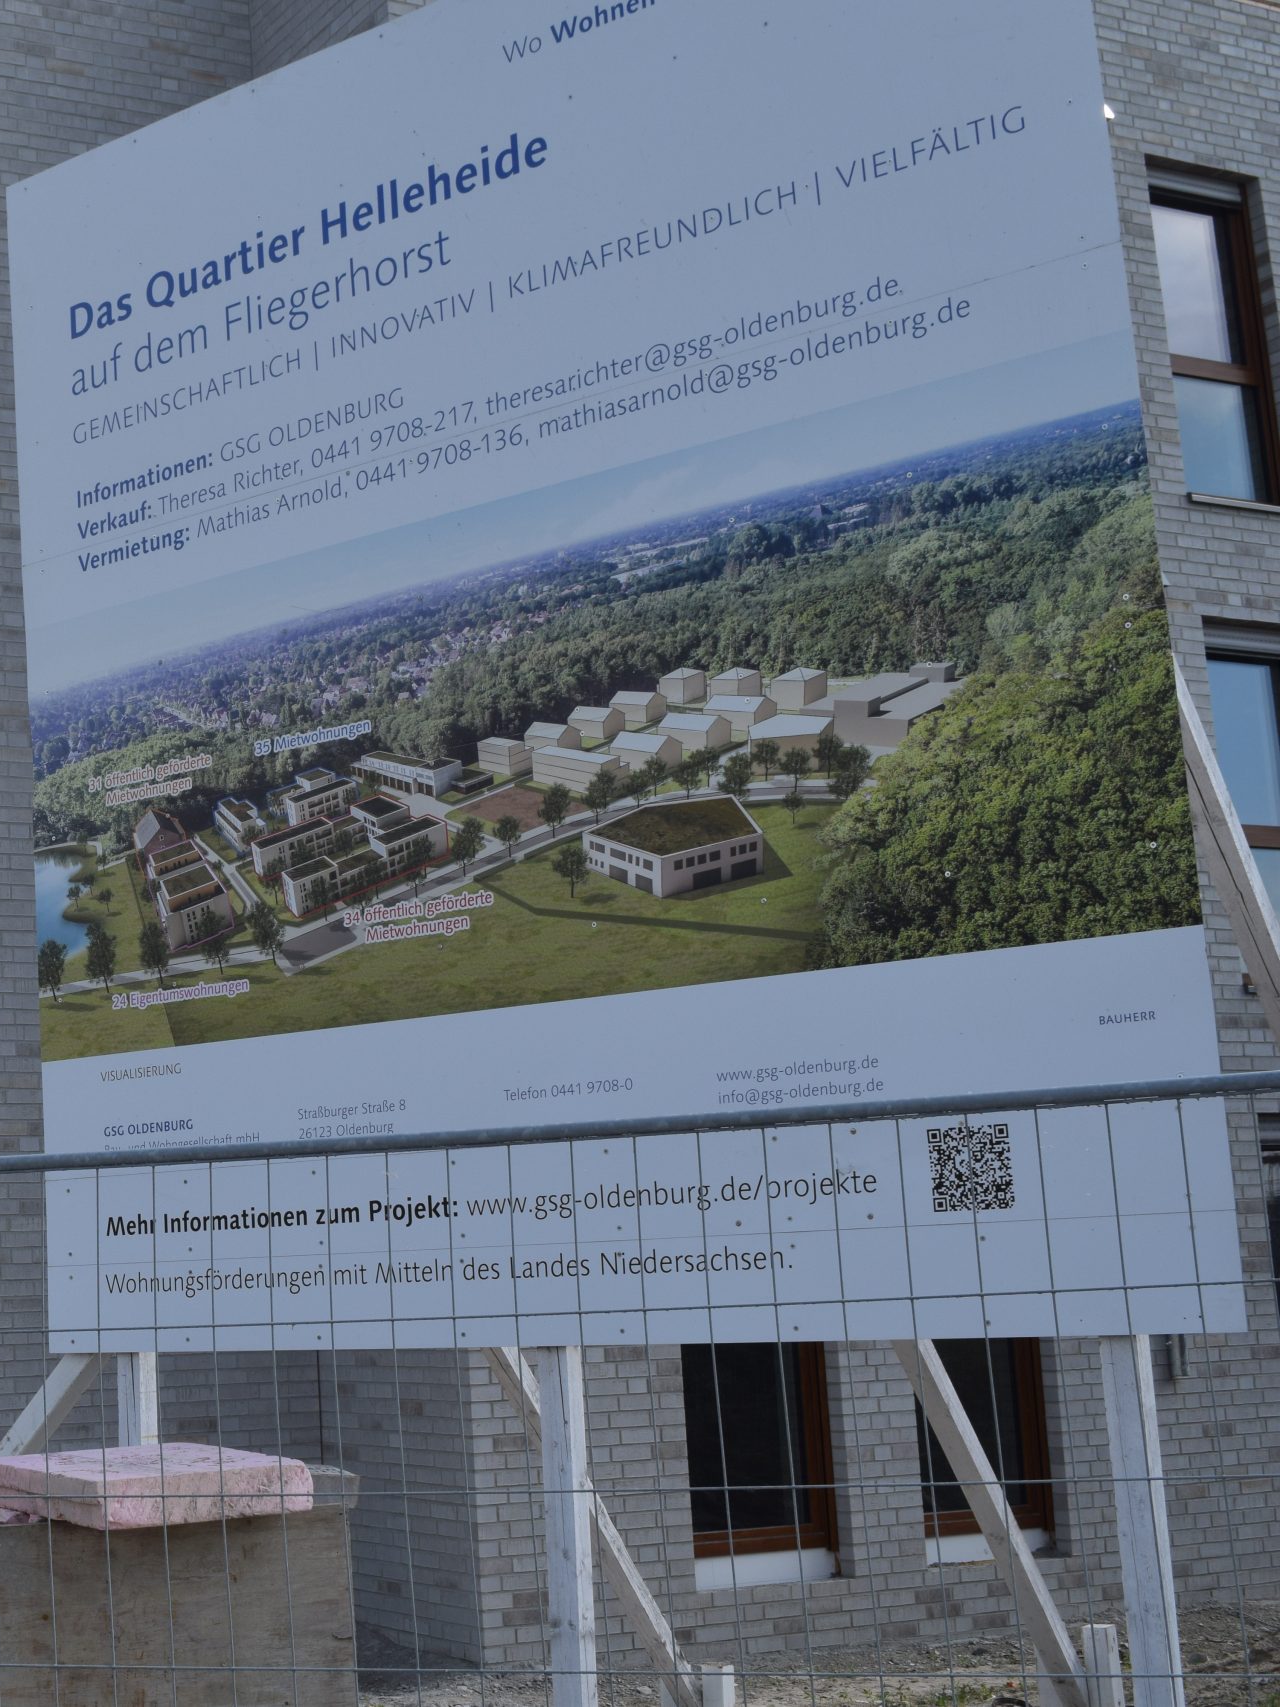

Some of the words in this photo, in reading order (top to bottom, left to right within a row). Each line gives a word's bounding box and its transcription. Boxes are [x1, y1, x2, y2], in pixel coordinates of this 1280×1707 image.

[502, 36, 542, 62] Wo
[69, 294, 133, 338] Das
[144, 226, 306, 308] Quartier
[320, 133, 548, 244] Helleheide
[73, 353, 302, 445] GEMEINSCHAFTLICH
[331, 289, 475, 357] INNOVATIV
[508, 180, 797, 297] KLIMAFREUNDLICH
[835, 105, 1026, 188] VIELFÄLTIG
[70, 343, 123, 394] auf
[134, 323, 208, 372] dem
[225, 231, 452, 340] Fliegerhorst
[77, 502, 153, 540] Verkauf:
[159, 480, 227, 517] Theresa
[234, 457, 304, 494] Richter,
[311, 437, 362, 468] 0441
[369, 403, 477, 451] 9708-217,
[486, 275, 899, 415] theresarichter@gsg-oldenburg.de
[76, 451, 214, 508] Informationen:
[219, 433, 262, 463] GSG
[268, 388, 405, 448] OLDENBURG
[78, 523, 191, 573] Vermietung:
[197, 501, 271, 538] Mathias
[276, 477, 350, 517] Arnold,
[355, 460, 408, 492] 0441
[417, 425, 530, 475] 9708-136,
[538, 297, 971, 437] mathiasarnold@gsg-oldenburg.de
[254, 741, 271, 756] 35
[273, 720, 372, 752] Mietwohnungen
[89, 777, 102, 791] 31
[106, 766, 154, 788] öffentlich
[157, 755, 211, 783] geförderte
[107, 777, 192, 804] Mietwohnungen
[344, 911, 361, 926] 34
[364, 898, 422, 922] öffentlich
[427, 891, 493, 916] geförderte
[365, 915, 469, 944] Mietwohnungen
[113, 995, 128, 1008] 24
[131, 979, 249, 1007] Eigentumswohnungen
[1098, 1010, 1156, 1025] BAUHERR
[101, 1063, 182, 1082] VISUALISIERUNG
[716, 1054, 879, 1084] www.gsg-oldenburg.de
[504, 1086, 547, 1102] Telefon
[551, 1082, 582, 1098] 0441
[586, 1078, 634, 1095] 9708-0
[718, 1077, 884, 1106] info@gsg-oldenburg.de
[298, 1104, 358, 1121] Straßburger
[361, 1100, 395, 1115] Straße
[399, 1099, 406, 1111] 8
[104, 1125, 124, 1137] GSG
[127, 1119, 193, 1135] OLDENBURG
[299, 1126, 332, 1140] 26123
[336, 1121, 393, 1137] Oldenburg
[106, 1214, 155, 1237] Mehr
[163, 1205, 308, 1233] Informationen
[315, 1206, 360, 1225] zum
[368, 1196, 458, 1227] Projekt:
[466, 1171, 878, 1220] www.gsg-oldenburg.de/projekte
[106, 1264, 325, 1297] Wohnungsförderungen
[334, 1264, 368, 1286] mit
[375, 1259, 452, 1284] Mitteln
[462, 1257, 499, 1281] des
[510, 1253, 590, 1279] Landes
[600, 1246, 793, 1276] Niedersachsen.
